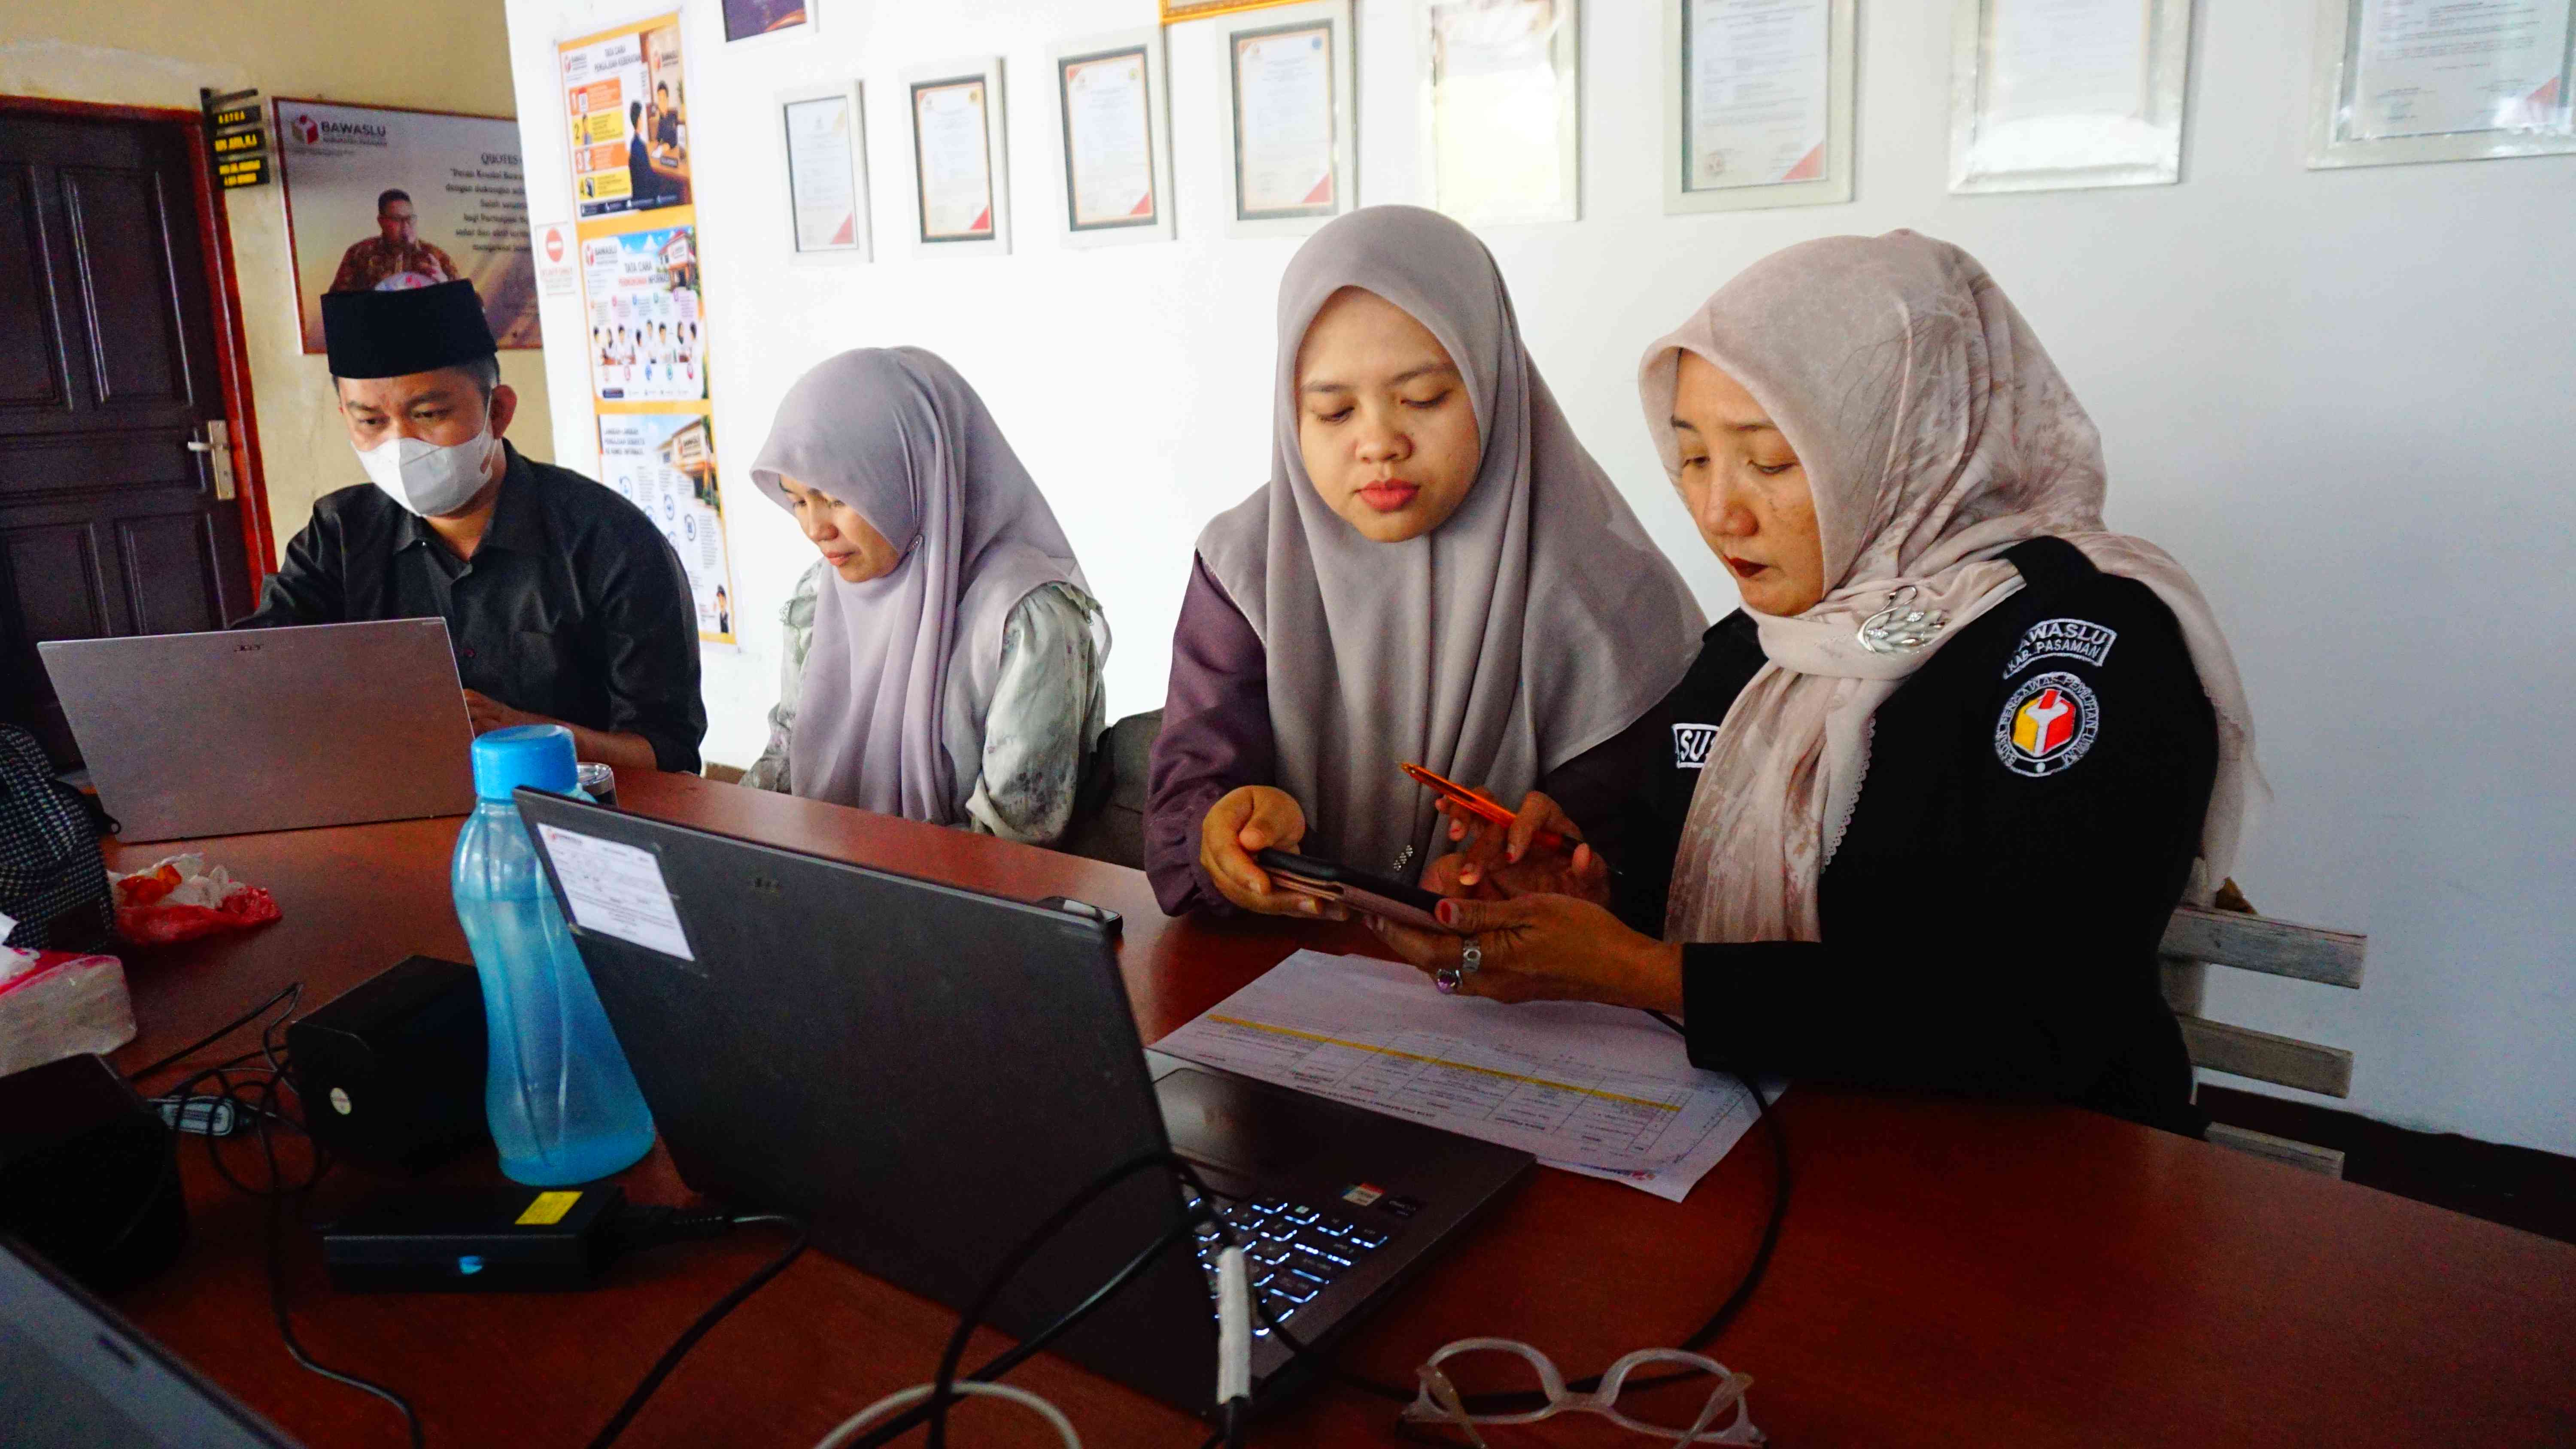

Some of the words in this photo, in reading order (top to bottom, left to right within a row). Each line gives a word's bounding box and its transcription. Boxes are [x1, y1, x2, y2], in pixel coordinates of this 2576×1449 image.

[321, 121, 386, 137] BAWASLU
[574, 123, 580, 140] 2
[481, 152, 518, 165] QUOTES
[625, 262, 637, 273] TATA
[638, 261, 653, 272] CARA
[2017, 623, 2107, 652] AWASLU
[2035, 639, 2101, 658] PASAMAN
[1680, 729, 1717, 762] SU
